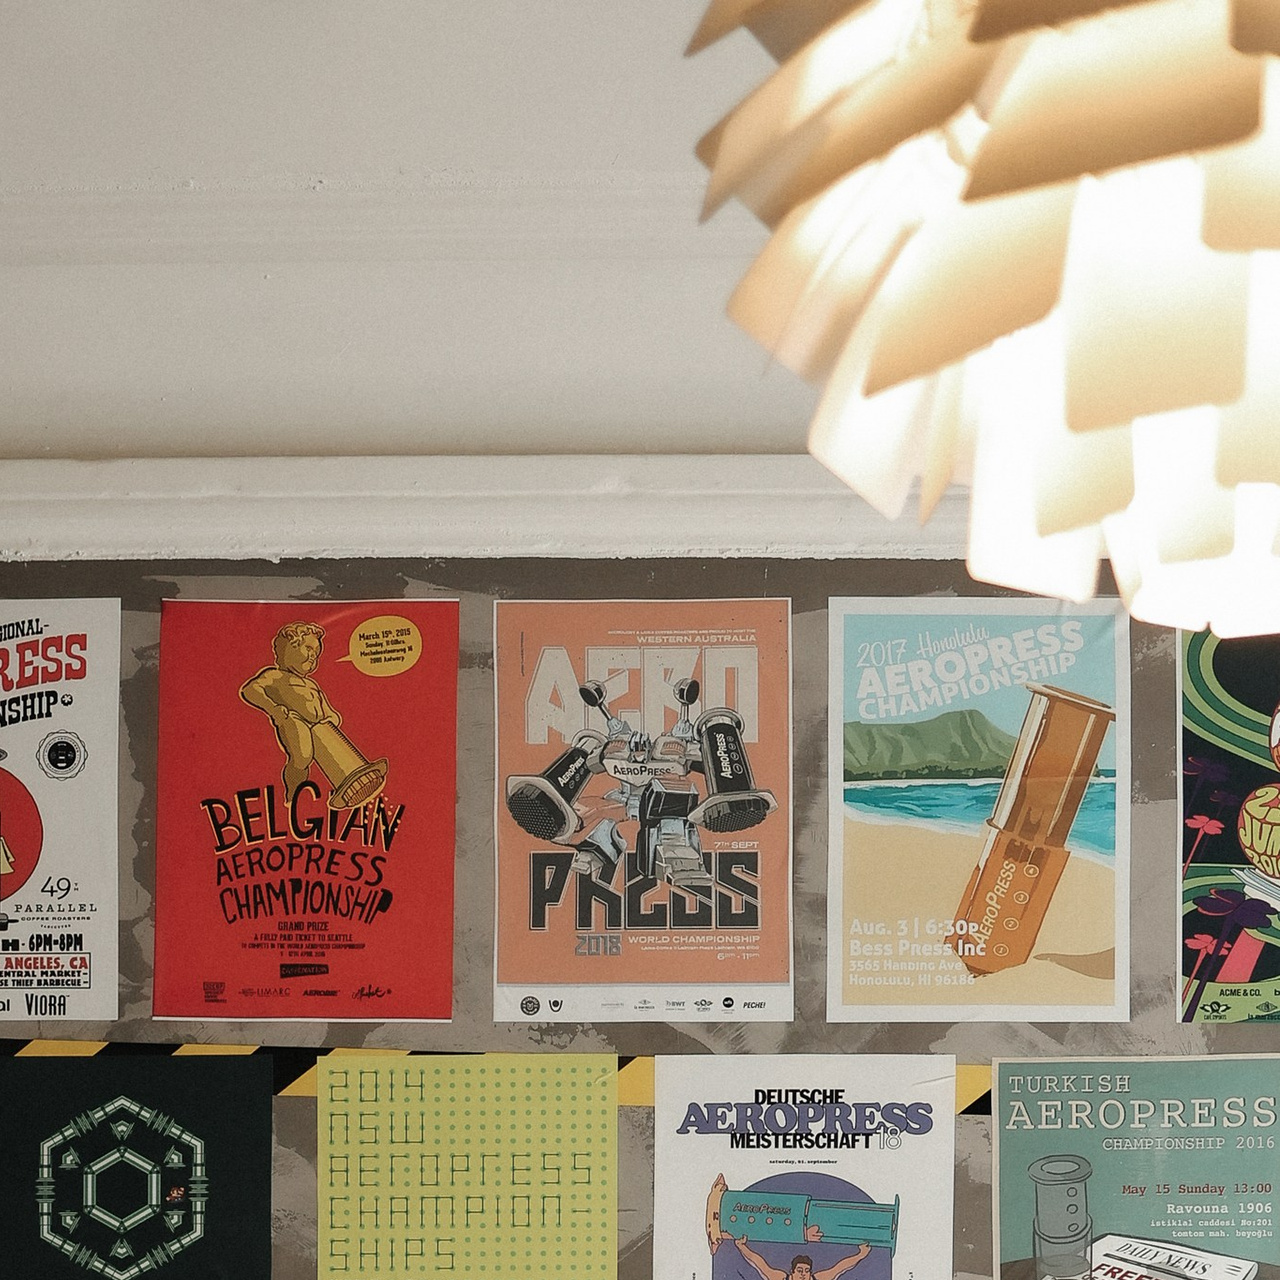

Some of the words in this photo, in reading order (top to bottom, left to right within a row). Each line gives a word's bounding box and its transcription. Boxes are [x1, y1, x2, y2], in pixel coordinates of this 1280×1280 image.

[857, 639, 907, 668] 2017
[917, 624, 990, 658] Honolulu
[856, 620, 1084, 699] AEROPRESS
[858, 653, 1076, 720] CHAMPIONSHIP
[200, 781, 404, 855] BELGIAN
[217, 844, 386, 886] AEROPRESS
[220, 879, 393, 924] CHAMPIONSHIP
[278, 922, 304, 931] GRAND
[307, 922, 329, 931] PRIZE
[575, 934, 622, 956] 2018
[673, 935, 760, 943] CHAMPIONSHIP
[70, 957, 88, 969] CA
[1220, 989, 1241, 997] ACME
[26, 994, 66, 1016] VIORA
[743, 1001, 766, 1009] PECHE!
[1009, 1075, 1130, 1094] TURKISH
[755, 1089, 844, 1104] DEUTSCHE
[676, 1102, 932, 1135] AEROPRESS
[1005, 1097, 1277, 1130] AEROPRESS
[730, 1133, 873, 1149] MEISTERSCHAFT
[876, 1126, 902, 1149] 18
[1102, 1138, 1224, 1150] CHAMPIONSHIP
[1236, 1137, 1275, 1148] 2016
[1122, 1185, 1146, 1196] May
[1156, 1185, 1170, 1194] 15
[1179, 1184, 1224, 1196] Sunday
[1234, 1184, 1272, 1193] 13:00
[1166, 1204, 1228, 1215] Ravouna
[1238, 1203, 1272, 1214] 1906
[1116, 1243, 1162, 1263] DAILY
[1159, 1251, 1212, 1275] NEWS
